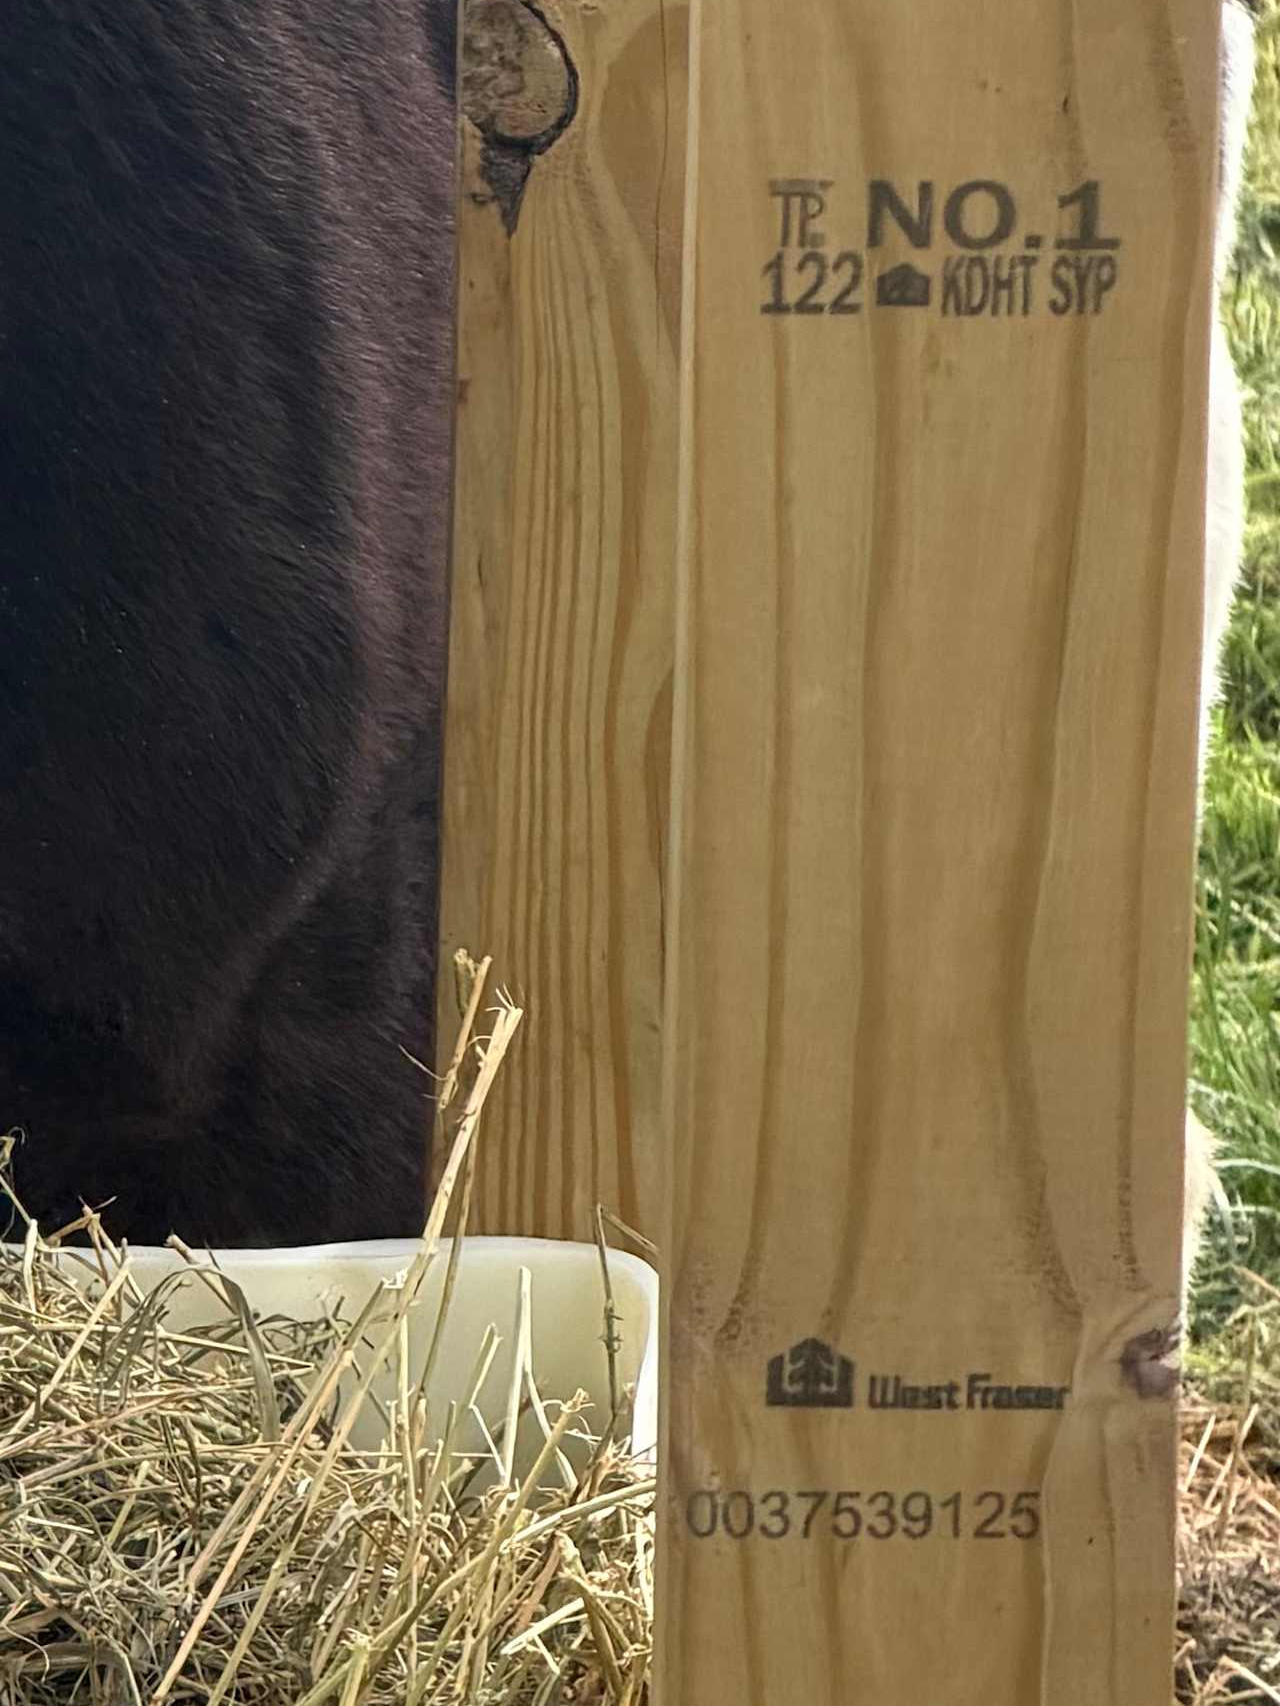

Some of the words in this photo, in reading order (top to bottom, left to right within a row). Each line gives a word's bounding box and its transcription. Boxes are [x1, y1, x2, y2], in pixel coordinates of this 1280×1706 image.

[867, 180, 1122, 250] NO.1
[760, 251, 864, 315] 122
[941, 254, 1038, 316] KDHT
[1048, 255, 1118, 316] SYP
[868, 1374, 960, 1410] West
[685, 1491, 1041, 1540] 0037539125
